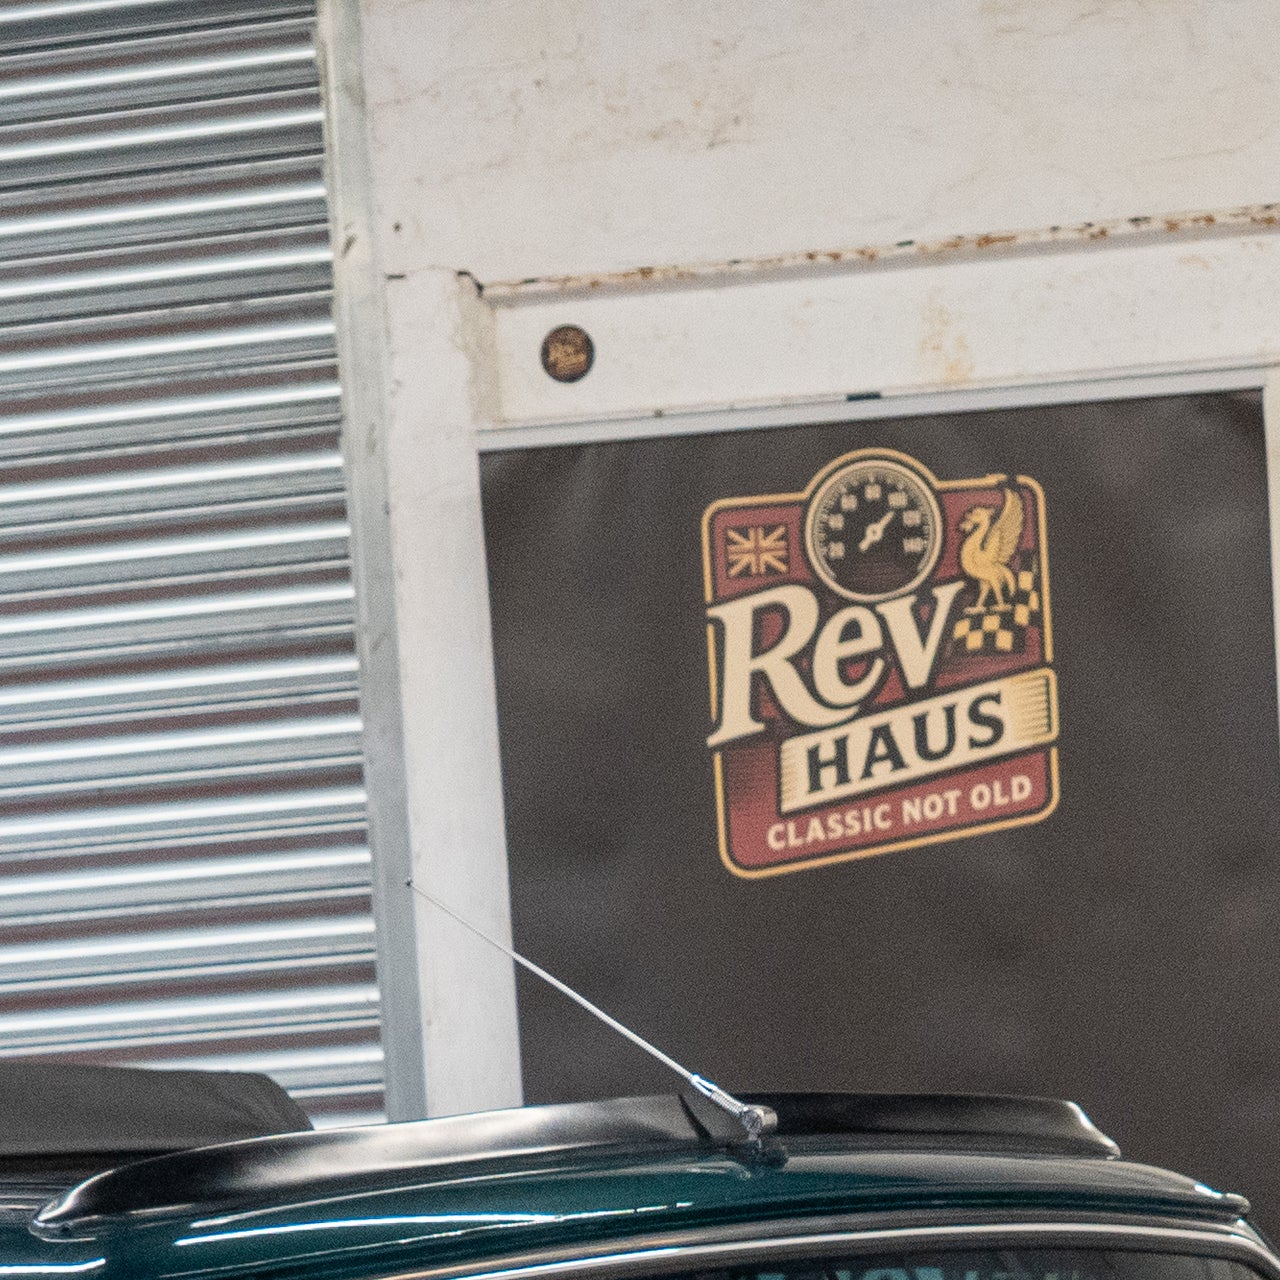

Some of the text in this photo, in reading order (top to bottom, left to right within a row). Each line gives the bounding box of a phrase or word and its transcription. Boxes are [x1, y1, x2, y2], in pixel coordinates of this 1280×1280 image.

[807, 692, 1004, 793] HAUS
[767, 775, 1033, 850] CLASSIC NOT OLD
